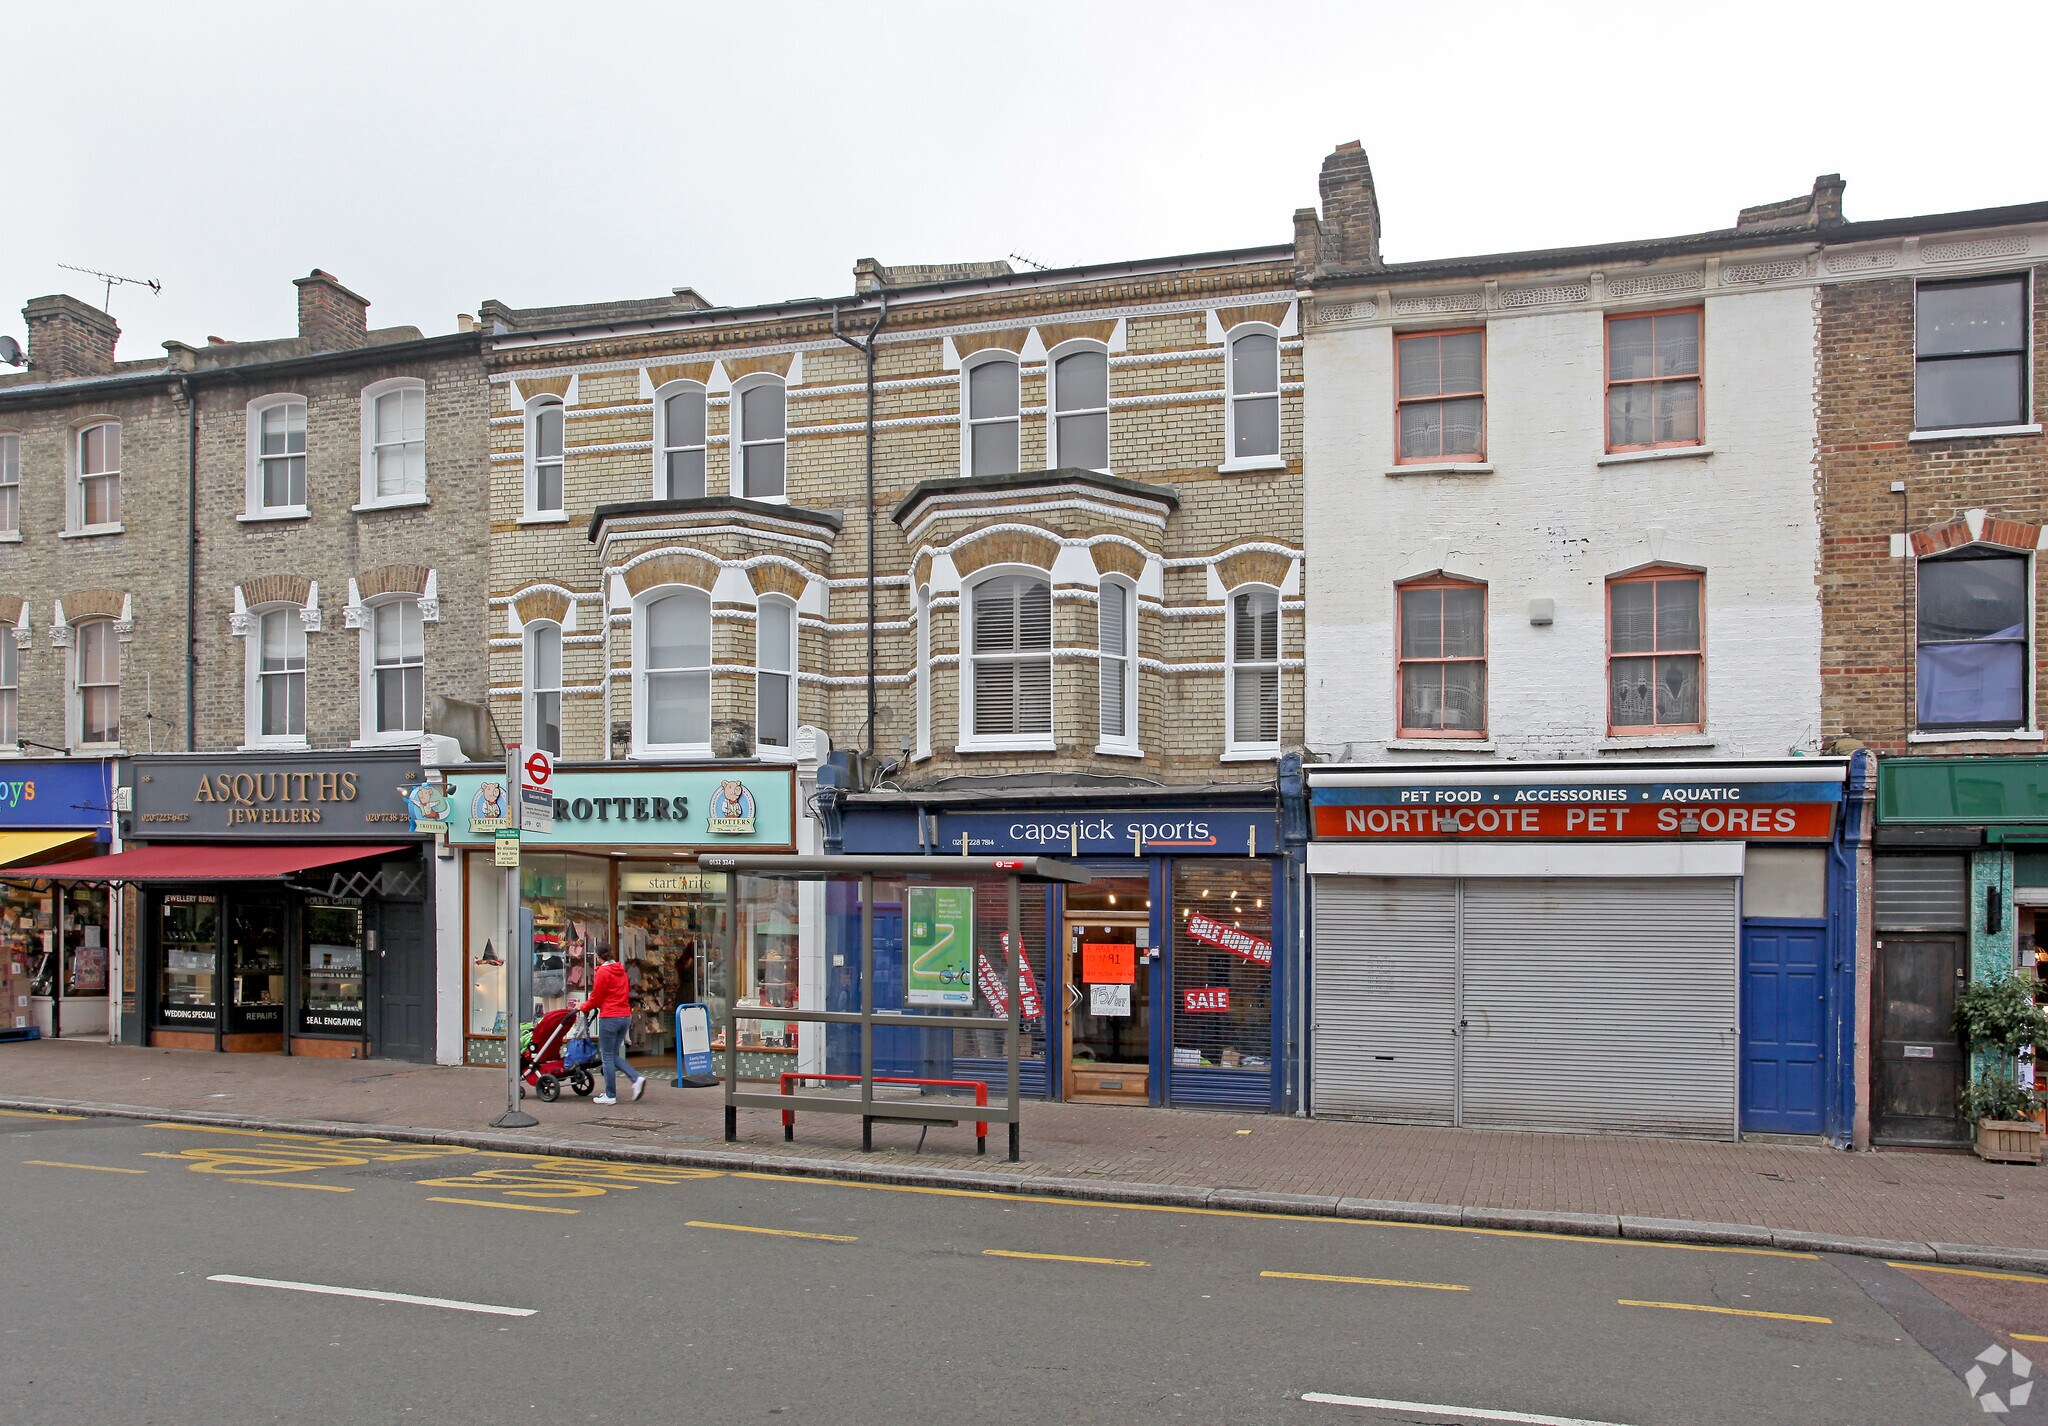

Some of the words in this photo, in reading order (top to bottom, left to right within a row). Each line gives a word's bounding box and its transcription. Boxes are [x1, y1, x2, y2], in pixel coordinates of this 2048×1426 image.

[405, 771, 415, 779] 88
[194, 771, 358, 806] ASQUITHS
[1514, 789, 1627, 802] ACCESSORIES
[1661, 788, 1740, 802] AQUATIC
[1401, 791, 1430, 802] PET
[1435, 791, 1482, 802] FOOD
[552, 797, 689, 821] ROTTERS
[227, 808, 322, 827] JEWELLERS
[1345, 808, 1540, 832] NORTHCOTE
[1566, 808, 1630, 831] PET
[1657, 807, 1796, 832] STORES
[1125, 820, 1209, 844] sports
[649, 877, 677, 889] start
[689, 876, 711, 889] rite
[164, 895, 197, 903] JEWELLERY
[1189, 916, 1222, 942] SALE
[1220, 929, 1254, 955] NOW
[1186, 992, 1227, 1009] SALE
[164, 1009, 191, 1018] WEDDING
[246, 1012, 277, 1020] REPAIRS
[306, 1016, 323, 1025] SEAL
[324, 1017, 362, 1026] ENGRAVING
[140, 1137, 479, 1175] STOP
[415, 1160, 726, 1198] BUS
